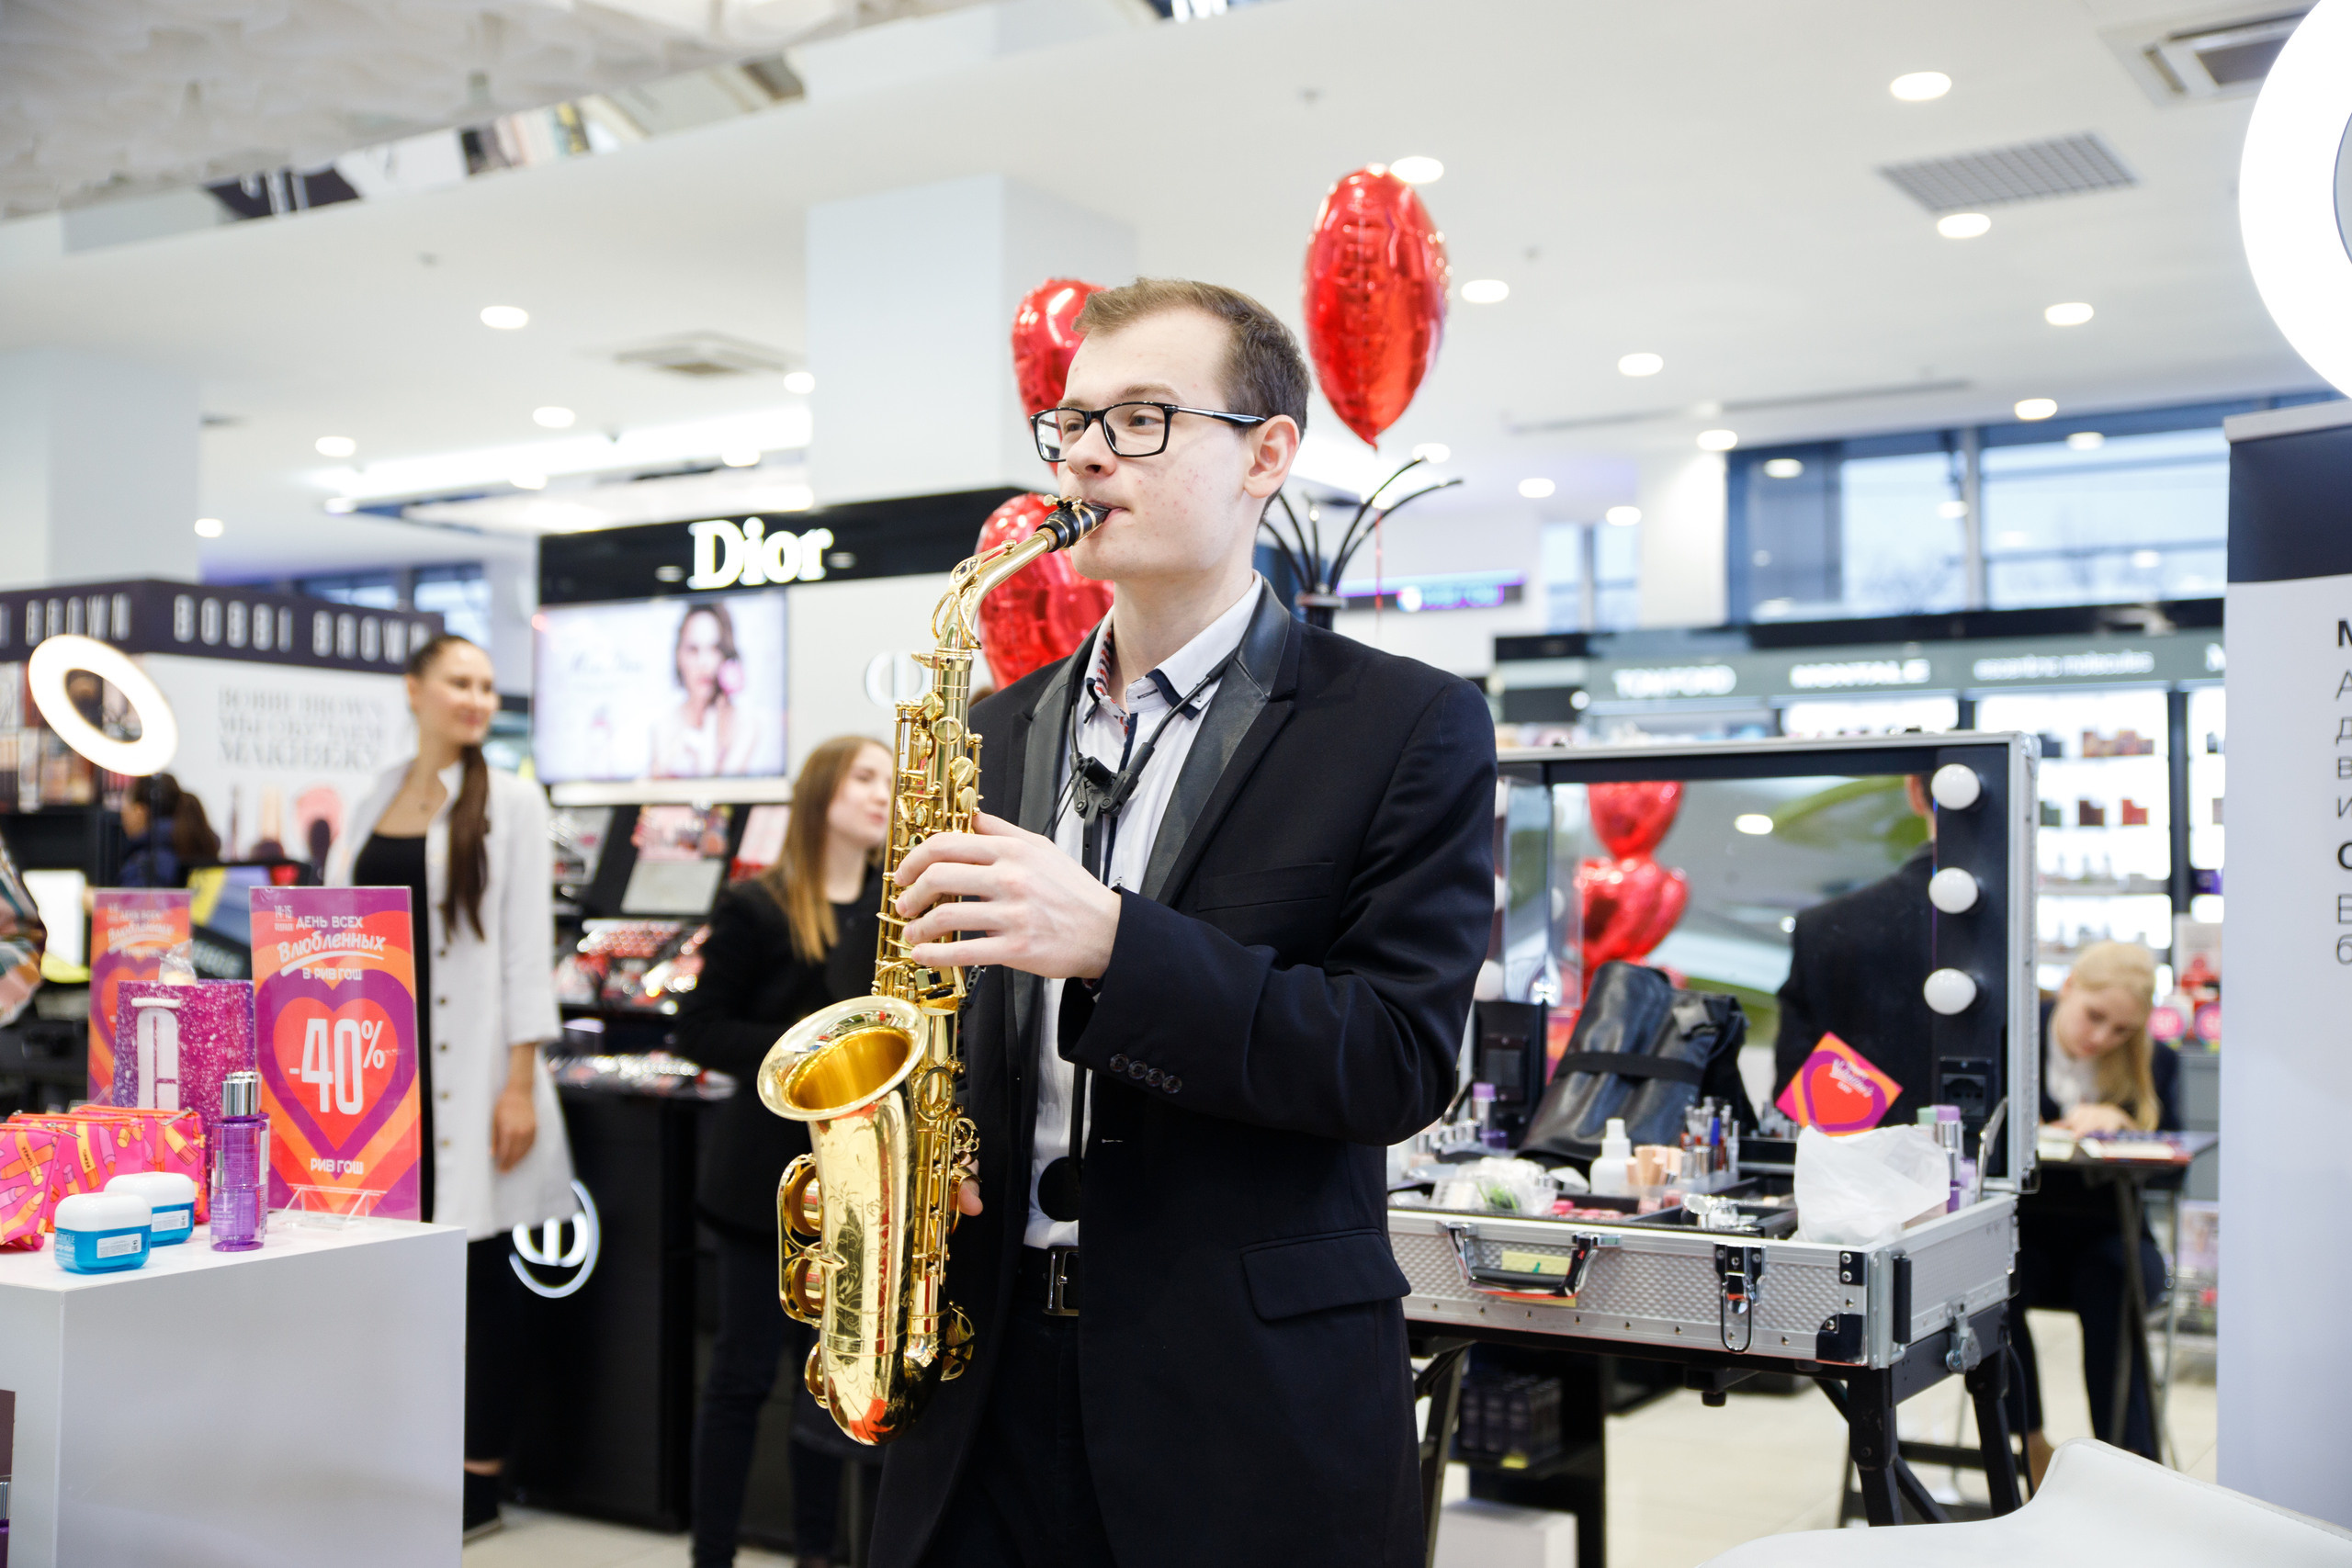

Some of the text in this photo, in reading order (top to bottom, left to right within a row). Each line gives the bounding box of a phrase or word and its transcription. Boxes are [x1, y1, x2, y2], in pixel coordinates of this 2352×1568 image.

[687, 516, 834, 590] Dior
[174, 593, 292, 653] BOBBI
[296, 916, 364, 930] ДЕНЬ ВСЕХ
[277, 930, 387, 964] Влюбленных
[288, 1018, 385, 1115] -40%
[311, 1157, 364, 1175] РИВ ГОШ
